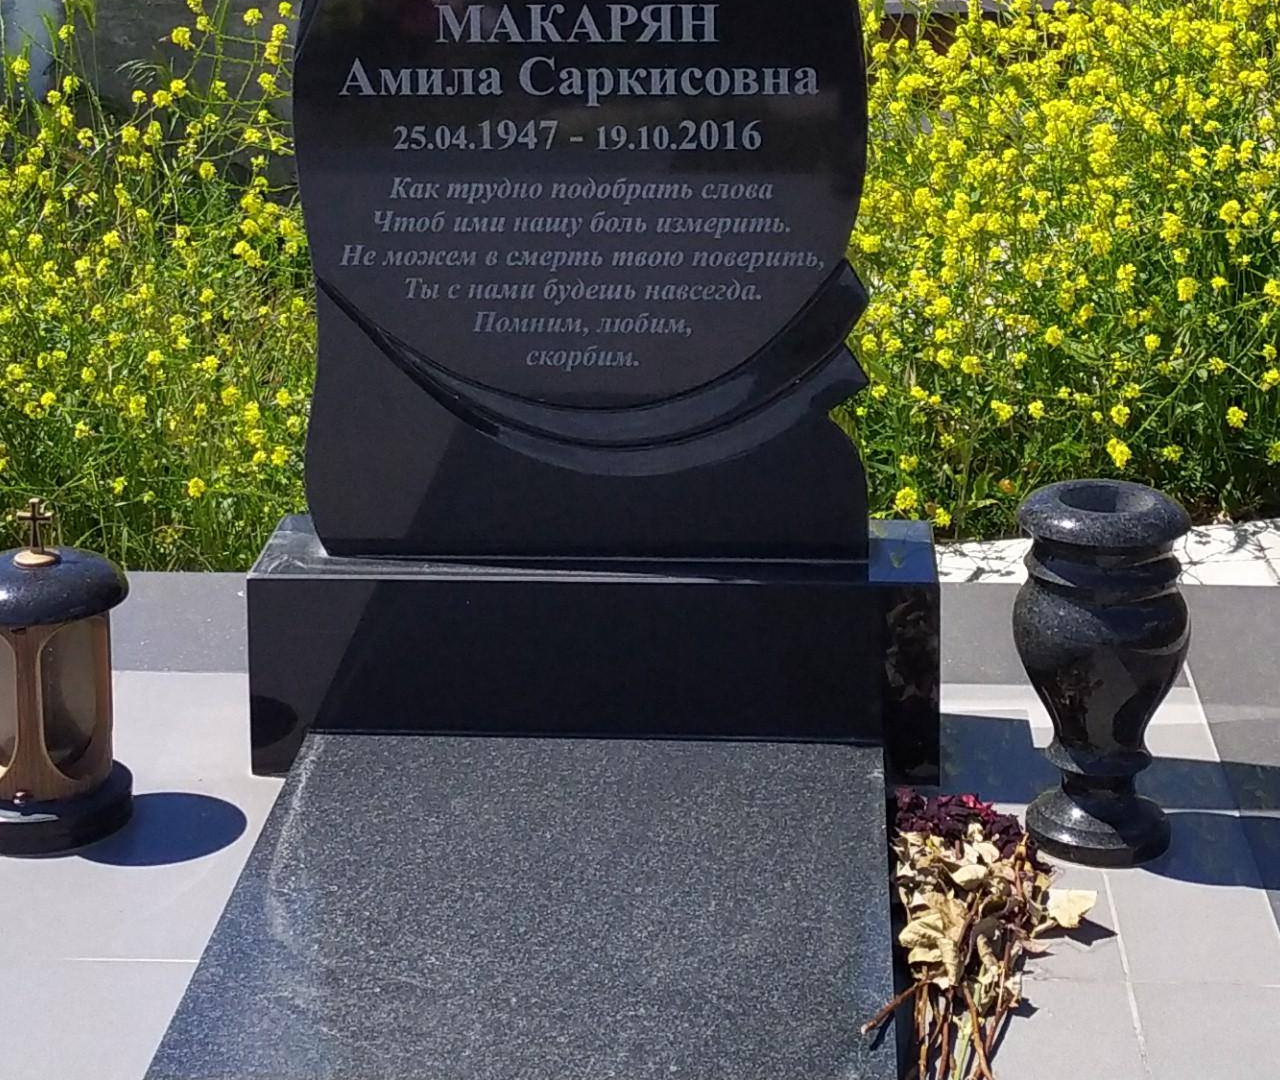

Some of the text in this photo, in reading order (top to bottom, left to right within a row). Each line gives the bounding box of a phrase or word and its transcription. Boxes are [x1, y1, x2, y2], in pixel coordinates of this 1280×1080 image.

[434, 3, 720, 43] МАКАРЯН
[339, 56, 820, 107] Амила Саркисовна
[393, 119, 559, 151] 25.04.1947
[596, 119, 762, 151] 19.10.2016
[389, 176, 774, 204] Как трудно подобрать слова
[374, 209, 791, 239] Чтоб ими нашу боль измерить.
[340, 243, 825, 273] Не можем в смерть твою поверить,
[405, 277, 762, 306] Ты с нами будешь навсегда.
[473, 311, 692, 337] Помним, любим,
[525, 345, 640, 372] скорбим.
